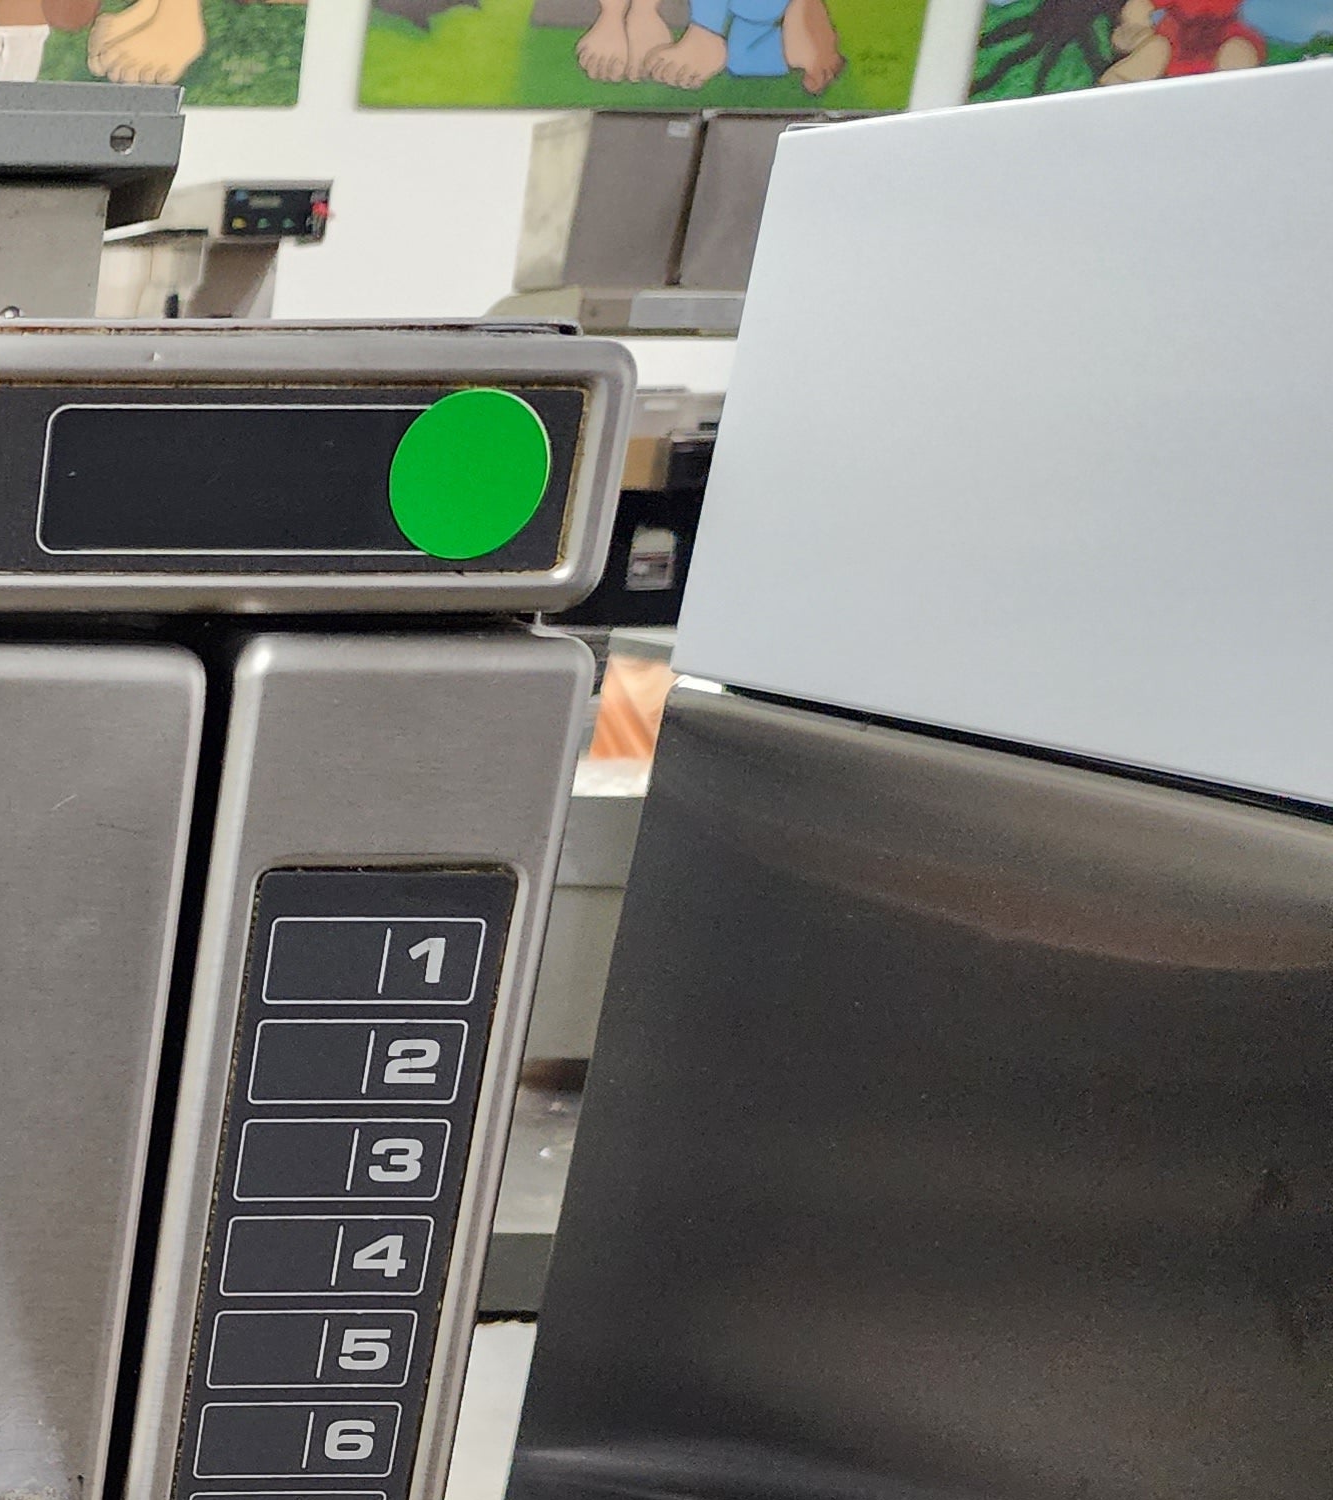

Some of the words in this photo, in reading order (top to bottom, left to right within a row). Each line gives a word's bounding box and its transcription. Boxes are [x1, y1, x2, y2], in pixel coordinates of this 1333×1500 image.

[408, 937, 447, 984] 1
[383, 1039, 442, 1085] 2
[368, 1138, 424, 1183] 3
[352, 1234, 407, 1278] 4
[338, 1329, 392, 1371] 5
[323, 1419, 376, 1461] 6
